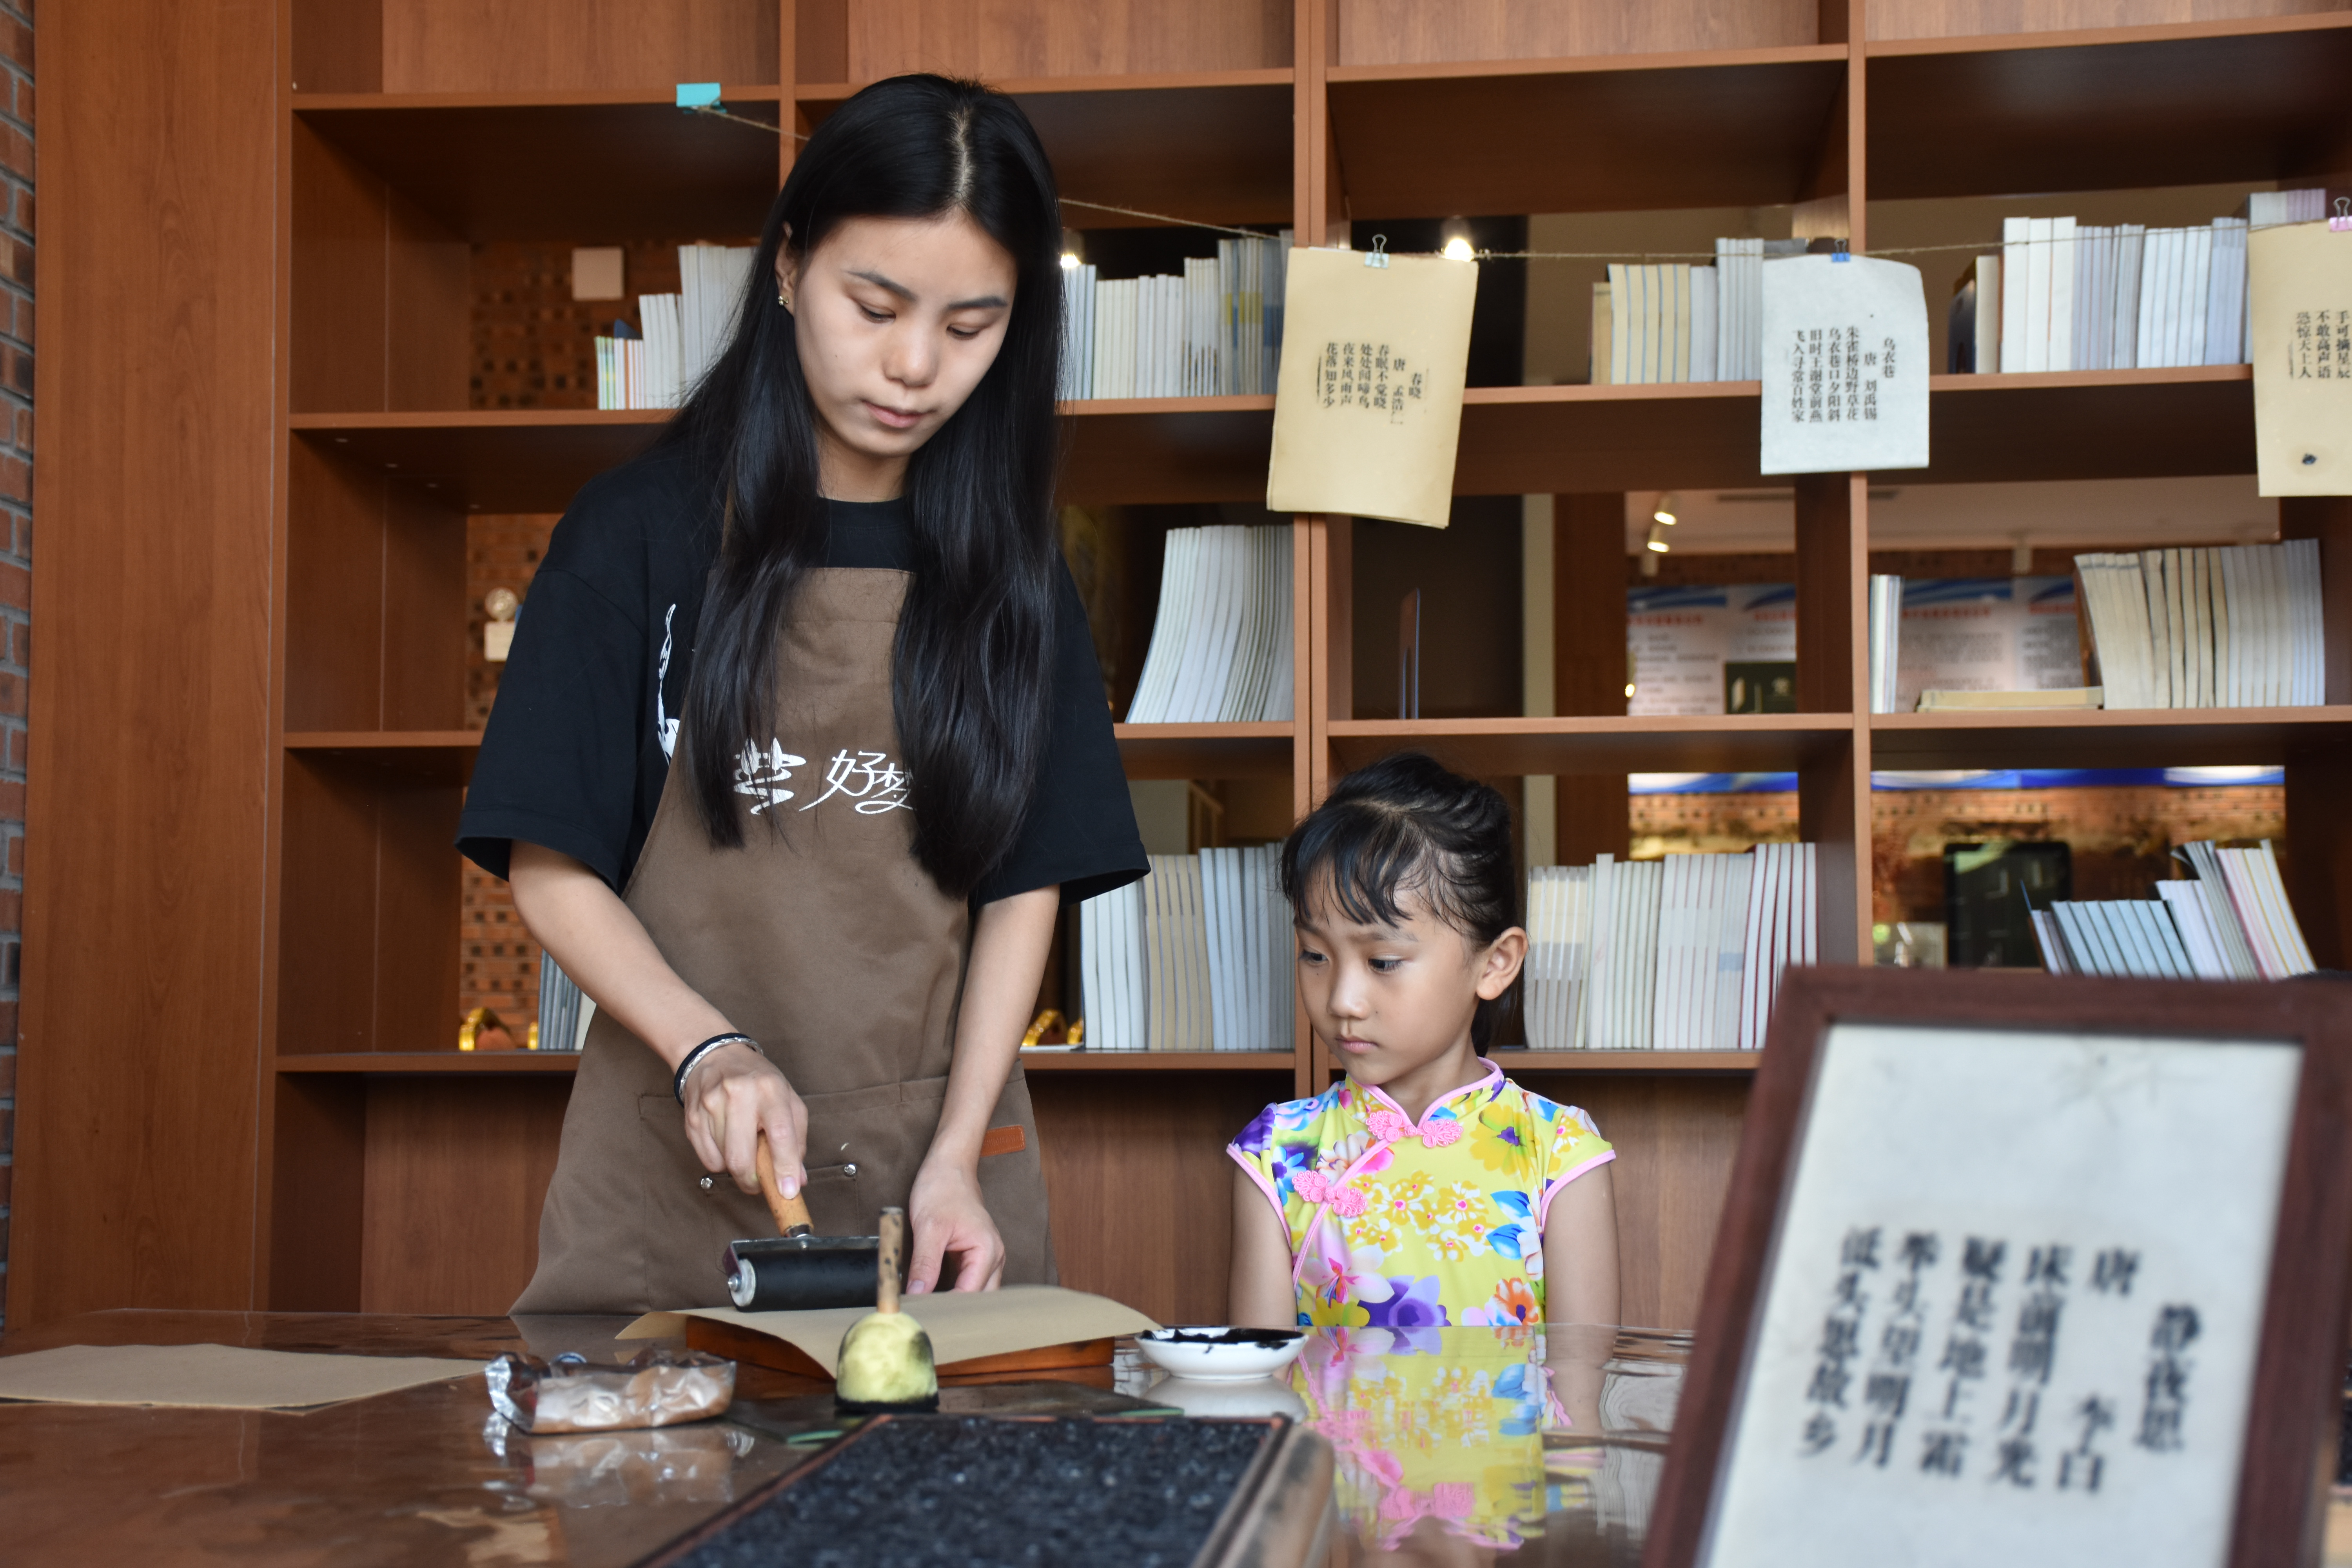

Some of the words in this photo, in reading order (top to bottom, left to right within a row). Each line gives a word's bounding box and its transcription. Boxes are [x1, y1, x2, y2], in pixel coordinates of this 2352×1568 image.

[1323, 341, 1338, 409] 花落知多少
[1340, 342, 1354, 407] 夜来风雨声
[1357, 343, 1373, 409] 处处闻啼鸟
[1374, 344, 1390, 410] 春眠不觉晓
[1393, 358, 1406, 372] 唐
[1791, 329, 1806, 423] 飞入寻常百姓家
[1808, 328, 1822, 423] 旧时王谢堂前燕
[1827, 327, 1842, 422] 乌衣巷口夕阳斜
[1844, 326, 1860, 421] 朱雀桥边野草花
[1864, 352, 1877, 366] 唐
[1882, 337, 1896, 379] 乌衣巷
[2296, 311, 2312, 380] 恐惊天上人
[2316, 309, 2330, 379] 不敢高声语
[2335, 309, 2351, 379] 手可摘星辰
[1408, 372, 1423, 399] 春晓
[1864, 379, 1878, 421] 刘禹锡
[2088, 1245, 2141, 1299] 唐
[1798, 1225, 1884, 1460] 低头思故乡
[1850, 1231, 1939, 1472] 举头望明月
[1918, 1235, 2007, 1479] 疑是地上霜
[1987, 1242, 2074, 1490] 床前明月光
[2132, 1301, 2204, 1454] 静夜思
[2056, 1391, 2118, 1497] 李白
